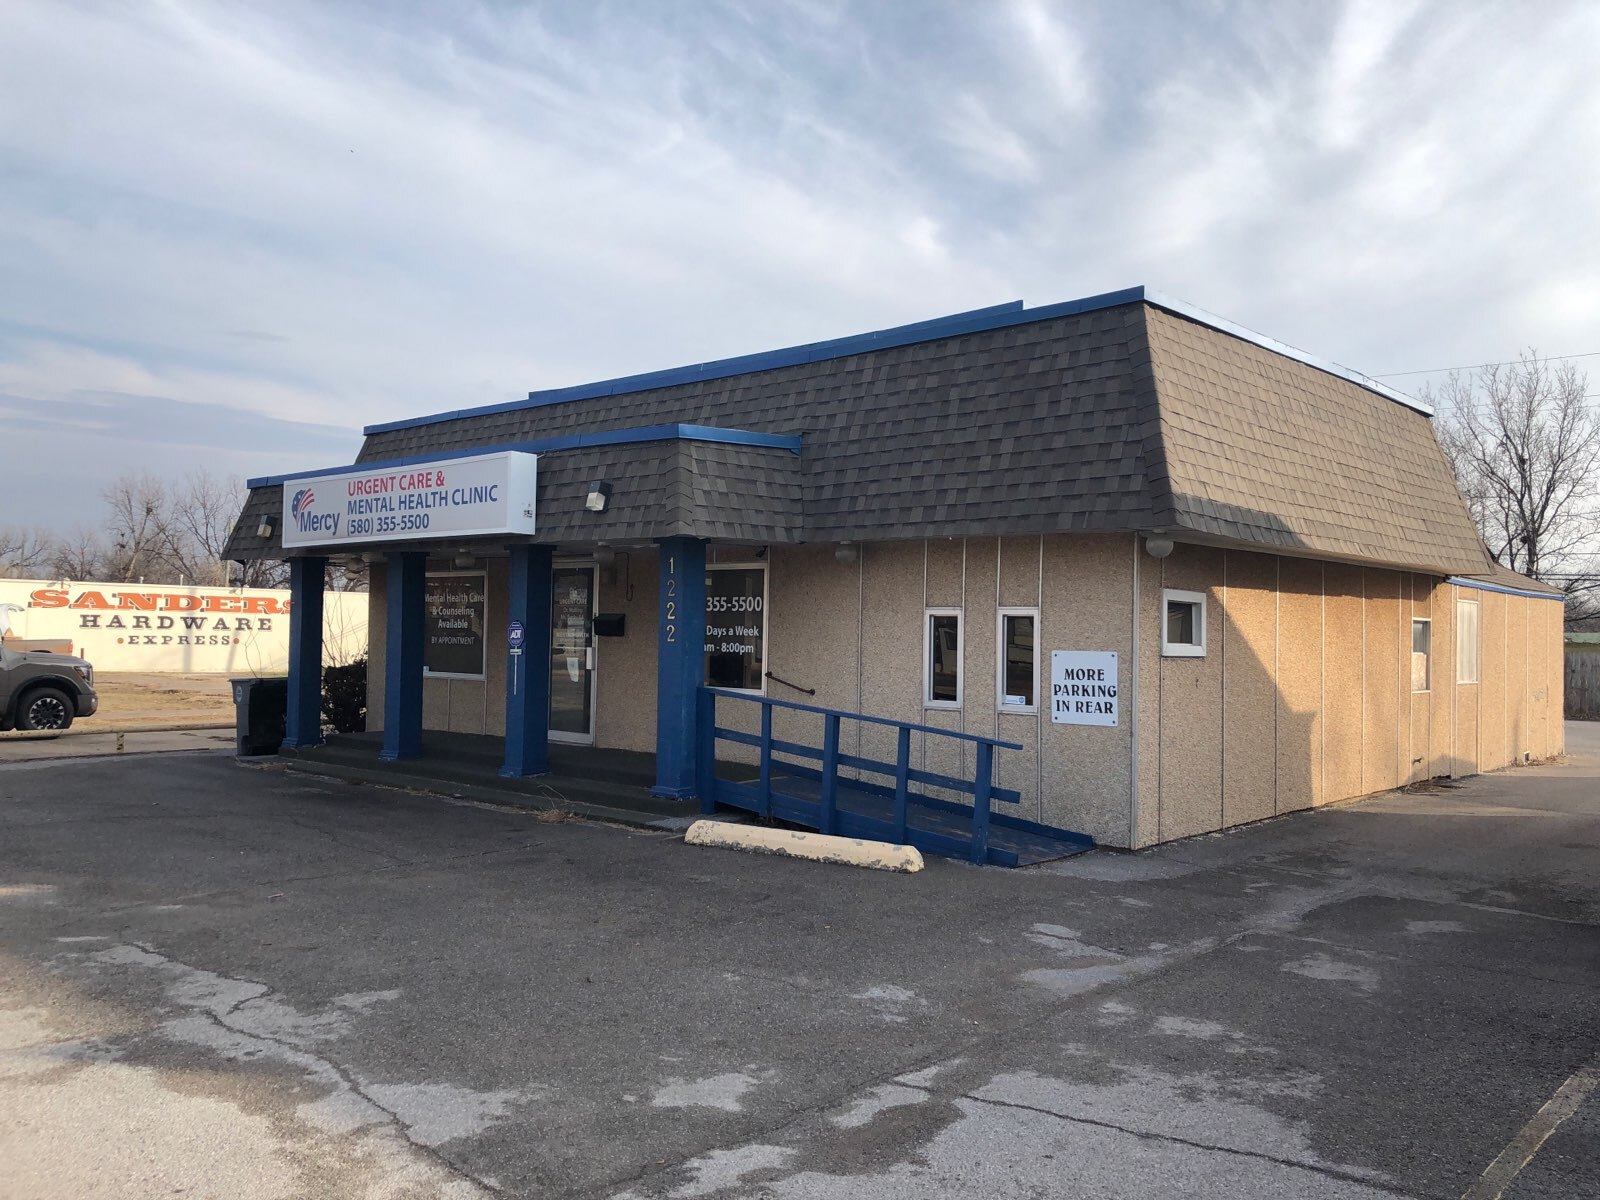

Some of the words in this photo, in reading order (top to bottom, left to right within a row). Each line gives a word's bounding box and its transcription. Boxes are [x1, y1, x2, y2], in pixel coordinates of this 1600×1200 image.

[348, 476, 396, 496] URGENT
[399, 471, 433, 491] CARE
[436, 470, 445, 487] &
[347, 496, 395, 516] MENTAL
[399, 490, 448, 511] HEALTH
[451, 484, 498, 506] CLINIC
[300, 511, 340, 536] Mercy
[347, 518, 373, 536] (580)
[377, 513, 429, 532] 355-5500
[447, 592, 468, 602] Health
[469, 592, 484, 602] Care
[705, 596, 762, 612] 355-5500
[438, 605, 475, 617] Counseling
[79, 614, 272, 631] HARDWARE
[438, 619, 468, 629] Available
[510, 629, 522, 639] ADT
[706, 625, 726, 638] Days
[728, 628, 734, 636] a
[735, 625, 760, 637] Week
[128, 635, 231, 646] EXPRESS
[431, 636, 437, 644] BY
[438, 636, 475, 645] APPOINTMENT
[721, 642, 754, 655] 8:00pm
[1064, 668, 1105, 681] MORE
[1053, 684, 1117, 698] PARKING
[1056, 699, 1070, 712] IN
[1075, 701, 1113, 714] REAR
